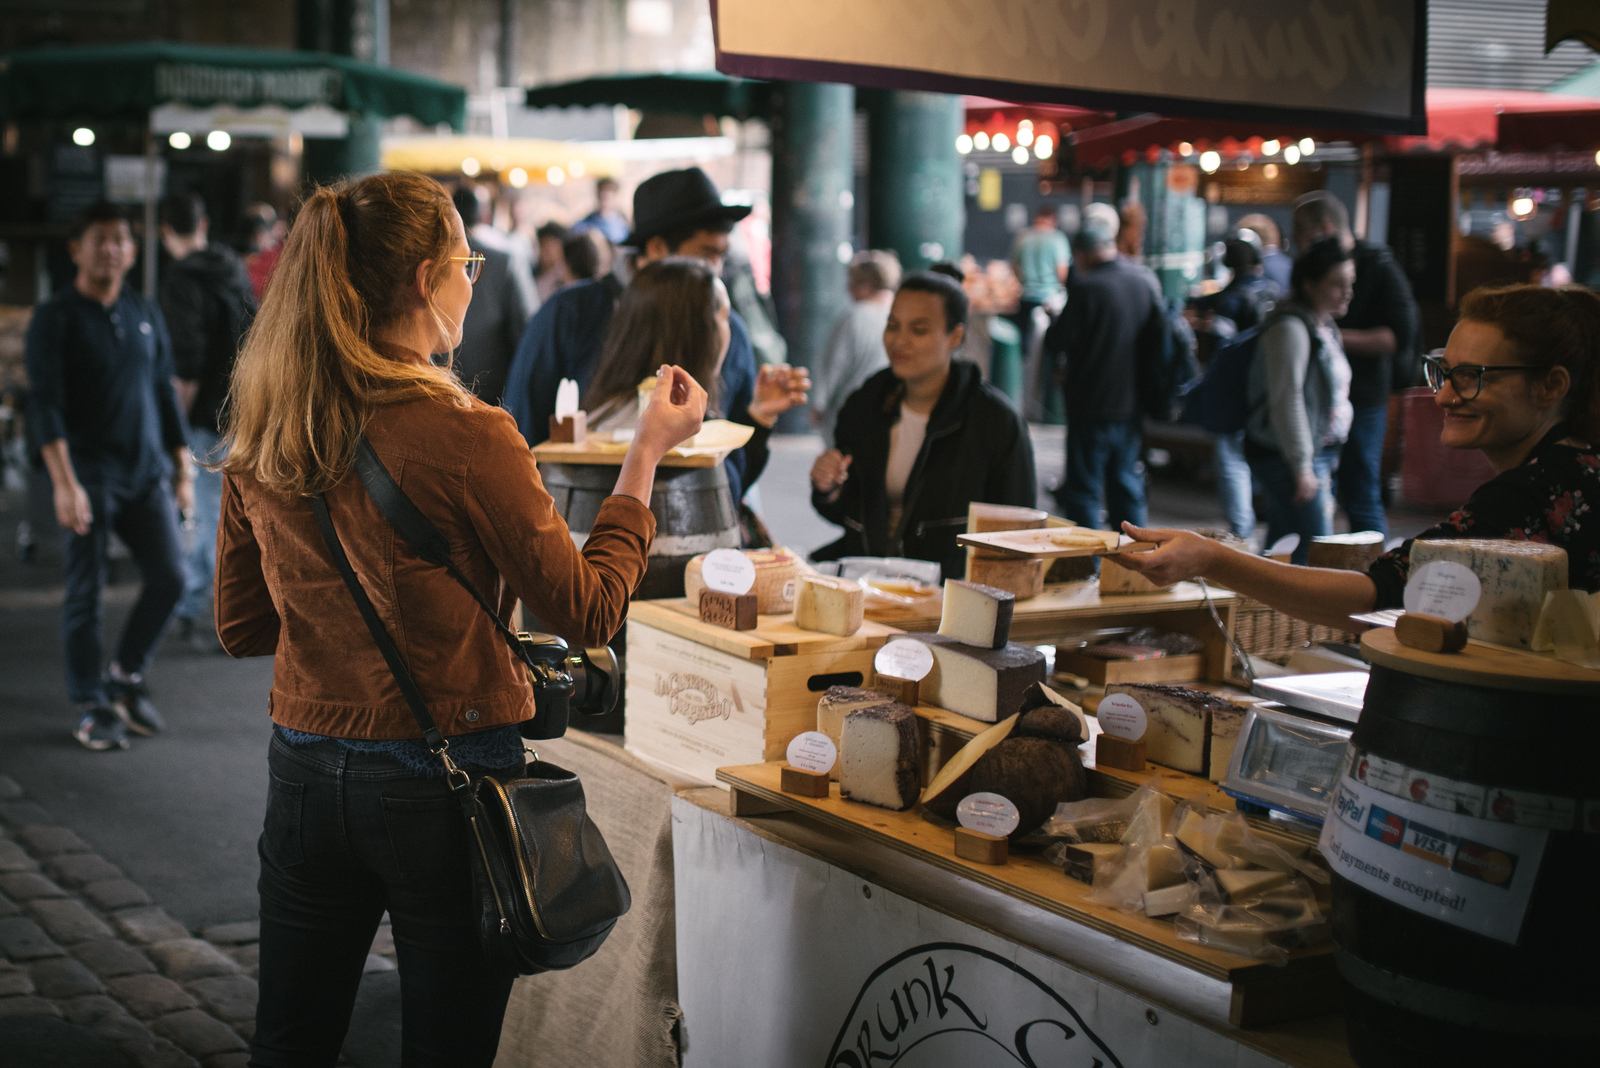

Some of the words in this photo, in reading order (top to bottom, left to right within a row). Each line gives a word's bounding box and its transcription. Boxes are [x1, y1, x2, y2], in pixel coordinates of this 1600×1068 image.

[1413, 833, 1447, 856] VISA
[1340, 849, 1391, 882] payments
[1392, 876, 1467, 913] accepted!
